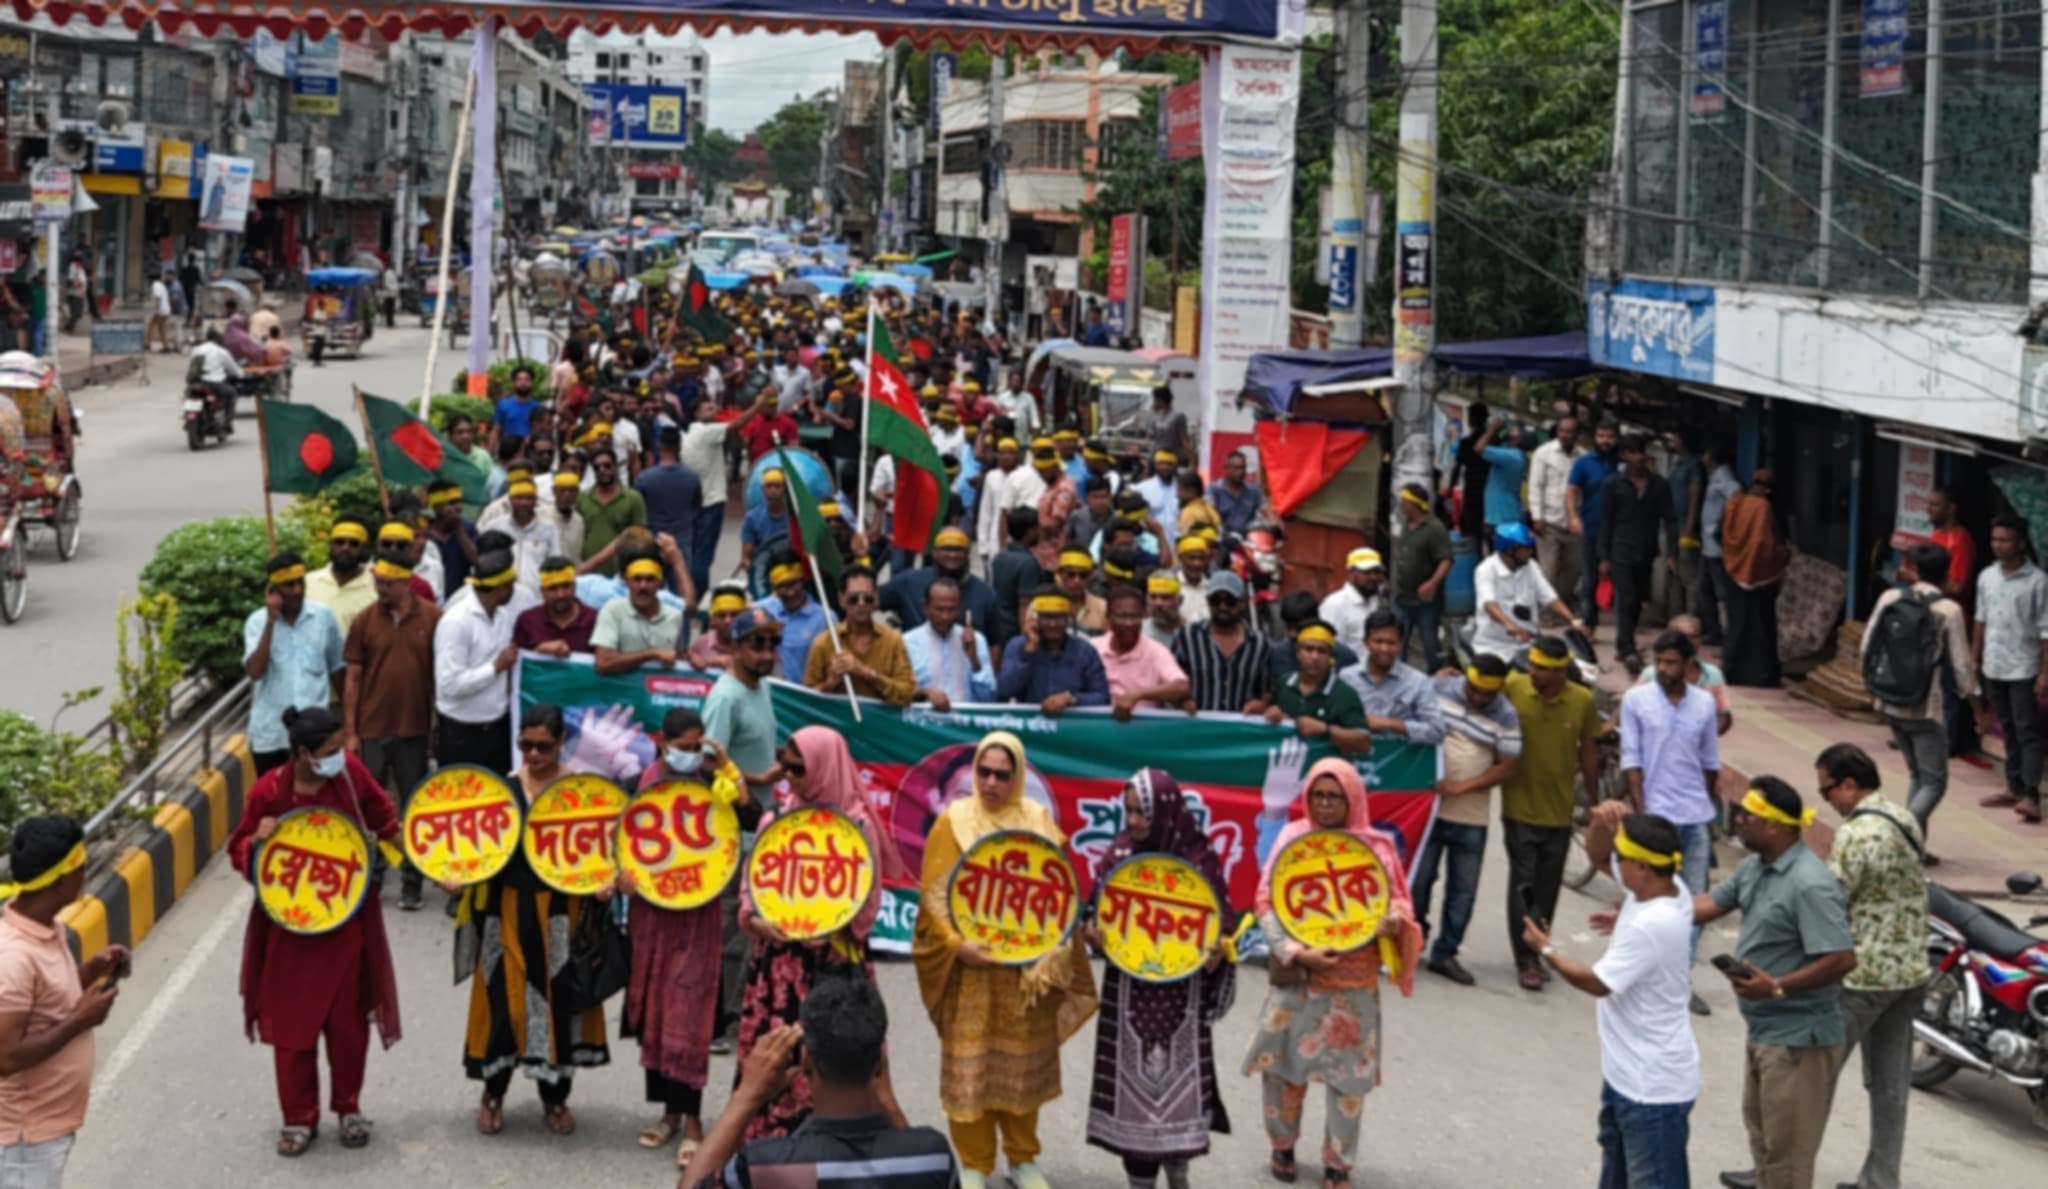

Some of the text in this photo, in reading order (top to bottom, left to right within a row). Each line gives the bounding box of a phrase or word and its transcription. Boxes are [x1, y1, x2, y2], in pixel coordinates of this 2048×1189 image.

[409, 800, 511, 855] সেবক
[528, 813, 620, 868] দলে
[623, 794, 714, 866] ৪৫
[262, 842, 363, 914] স্বেচ্ছা
[650, 861, 706, 899] তম
[753, 832, 865, 901] প্রতিষ্ঠা
[957, 849, 1075, 931] বার্ষিকী
[1283, 859, 1379, 919] হোক
[1100, 884, 1216, 951] সফল
